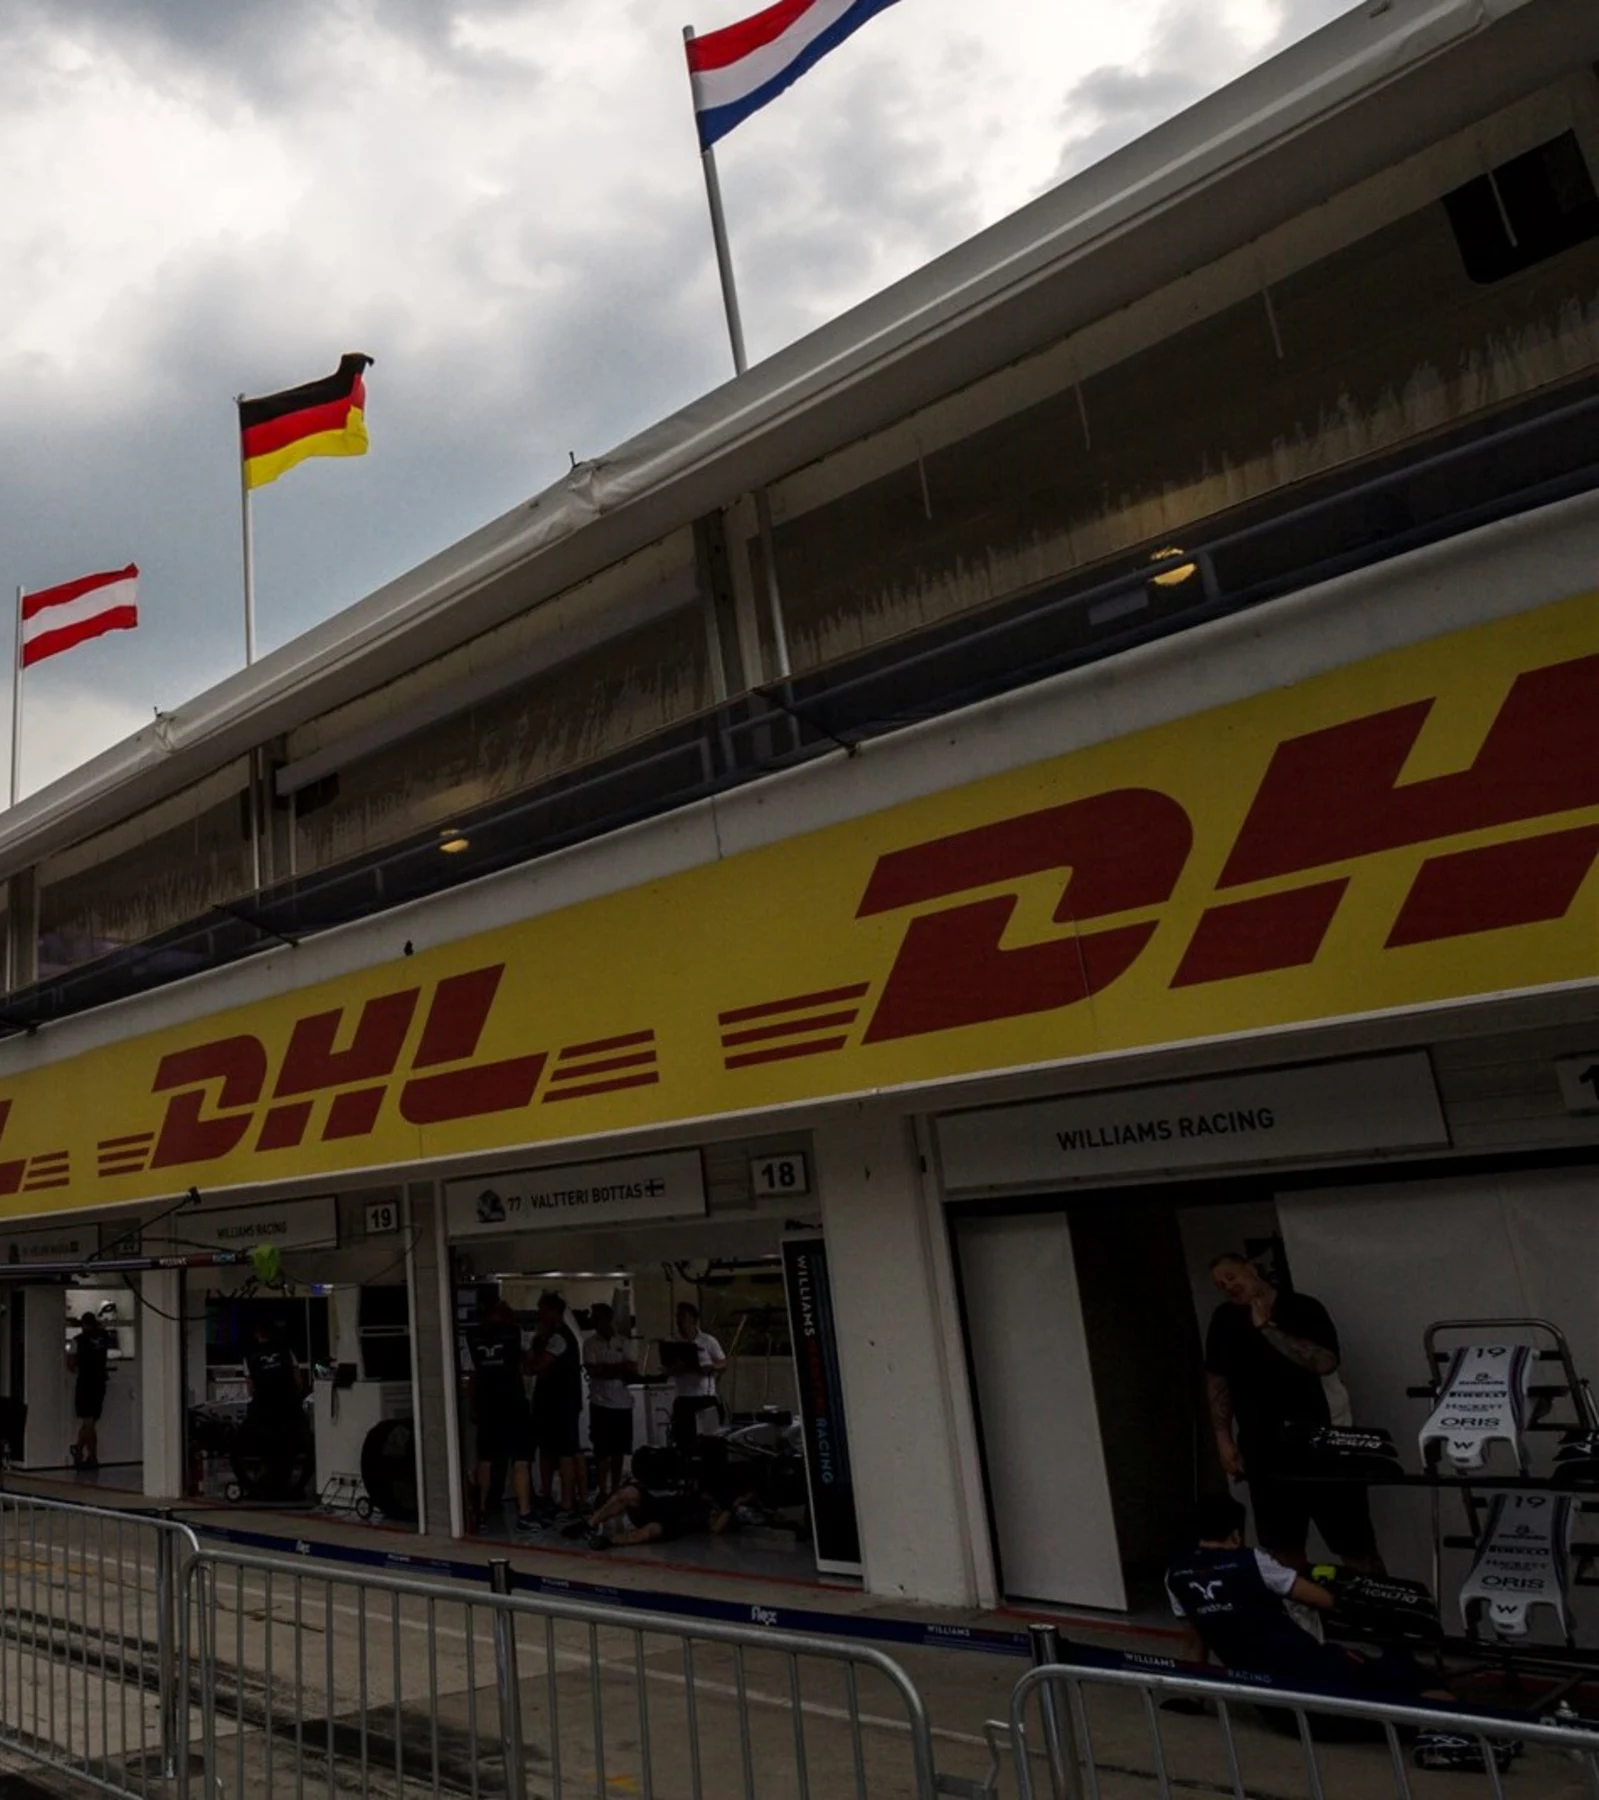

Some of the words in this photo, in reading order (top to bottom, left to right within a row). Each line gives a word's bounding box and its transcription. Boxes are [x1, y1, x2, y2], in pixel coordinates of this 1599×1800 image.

[854, 653, 1599, 1045] DH
[150, 963, 549, 1169] DHL
[1057, 1120, 1172, 1151] WILLIAMS
[1178, 1107, 1276, 1138] RACING
[761, 1162, 796, 1188] 18
[508, 1197, 522, 1211] 77
[530, 1189, 590, 1209] VALTTERI
[592, 1184, 643, 1203] BOTTAS
[371, 1204, 392, 1228] 19
[217, 1224, 254, 1239] WILLIAMS
[256, 1221, 287, 1236] RACING
[1475, 1347, 1506, 1359] 19
[796, 1255, 816, 1337] WILLIAMS
[815, 1416, 834, 1486] RACING
[1440, 1416, 1500, 1427] ORIS
[1452, 1440, 1475, 1450] W
[1514, 1495, 1546, 1509] 19
[1481, 1575, 1545, 1590] ORIS
[750, 1605, 778, 1625] flex
[1496, 1604, 1518, 1615] W
[925, 1624, 971, 1638] WILLIAMS
[1124, 1652, 1176, 1669] WILLIAMS
[1227, 1667, 1274, 1684] RACING
